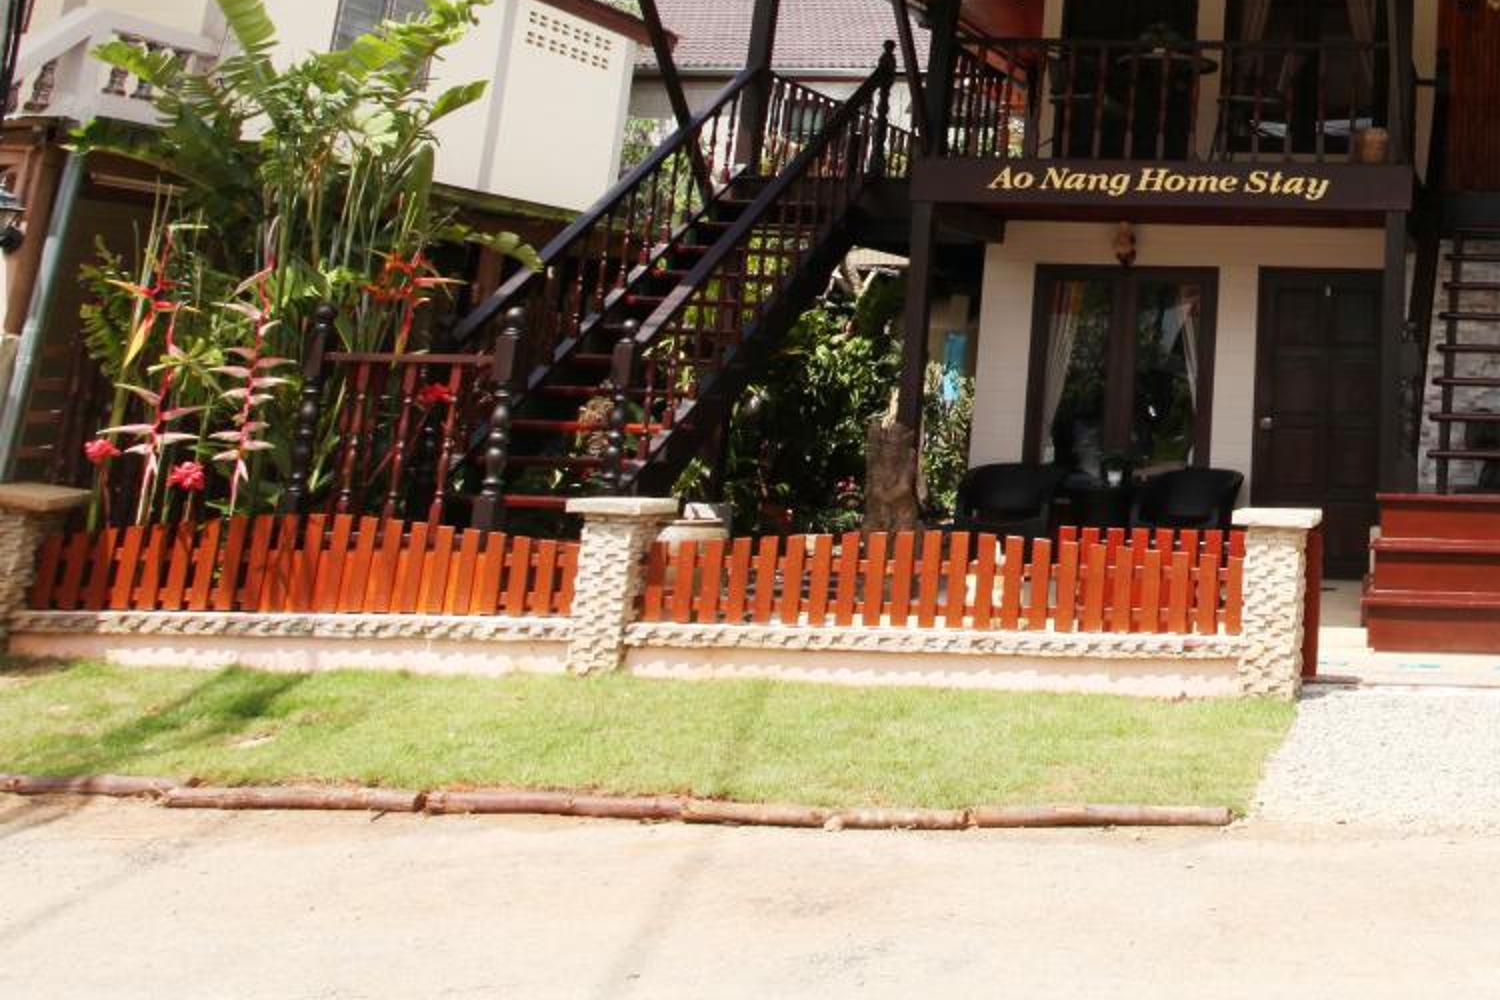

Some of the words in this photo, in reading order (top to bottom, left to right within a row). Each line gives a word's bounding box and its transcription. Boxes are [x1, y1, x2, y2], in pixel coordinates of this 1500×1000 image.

[987, 165, 1035, 190] Ao
[1039, 166, 1131, 198] Nang
[1135, 167, 1238, 194] Home
[1243, 170, 1329, 201] Stay
